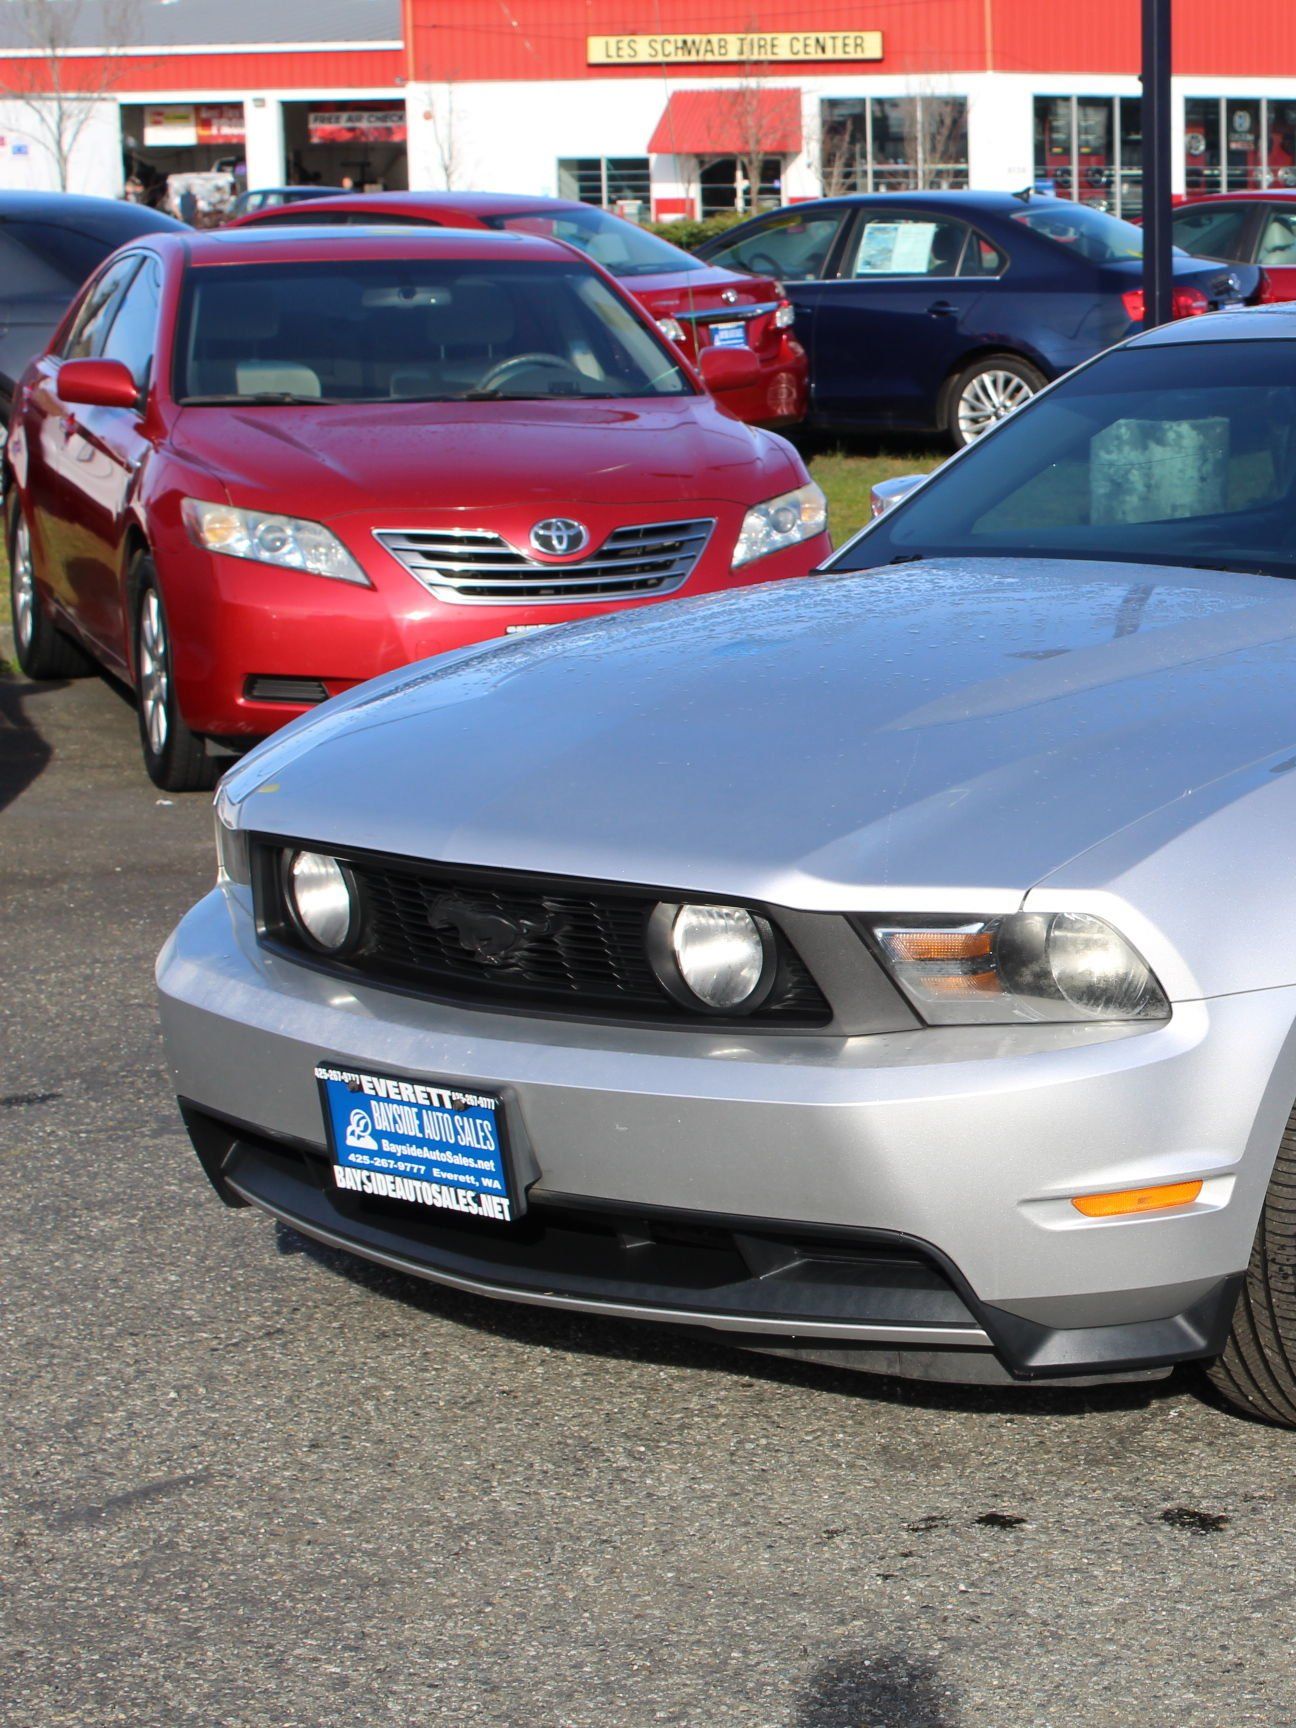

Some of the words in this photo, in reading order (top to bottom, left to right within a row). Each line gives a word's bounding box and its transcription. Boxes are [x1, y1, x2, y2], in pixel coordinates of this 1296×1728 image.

[605, 39, 637, 59] LES
[648, 38, 728, 58] SCHWAB
[737, 36, 778, 55] TIRE
[789, 35, 865, 56] CENTER
[360, 1074, 453, 1110] EVERETT
[370, 1099, 424, 1138] BAYSIDE
[422, 1109, 456, 1144] AUTO
[454, 1115, 496, 1151] SALES
[347, 1152, 426, 1175] 425-267-9777
[432, 1167, 480, 1187] Everett,
[481, 1177, 502, 1190] WA
[381, 1138, 496, 1172] BaysideAutoSales.net
[333, 1165, 511, 1222] BAYSIDEAUTOSALES.NET
